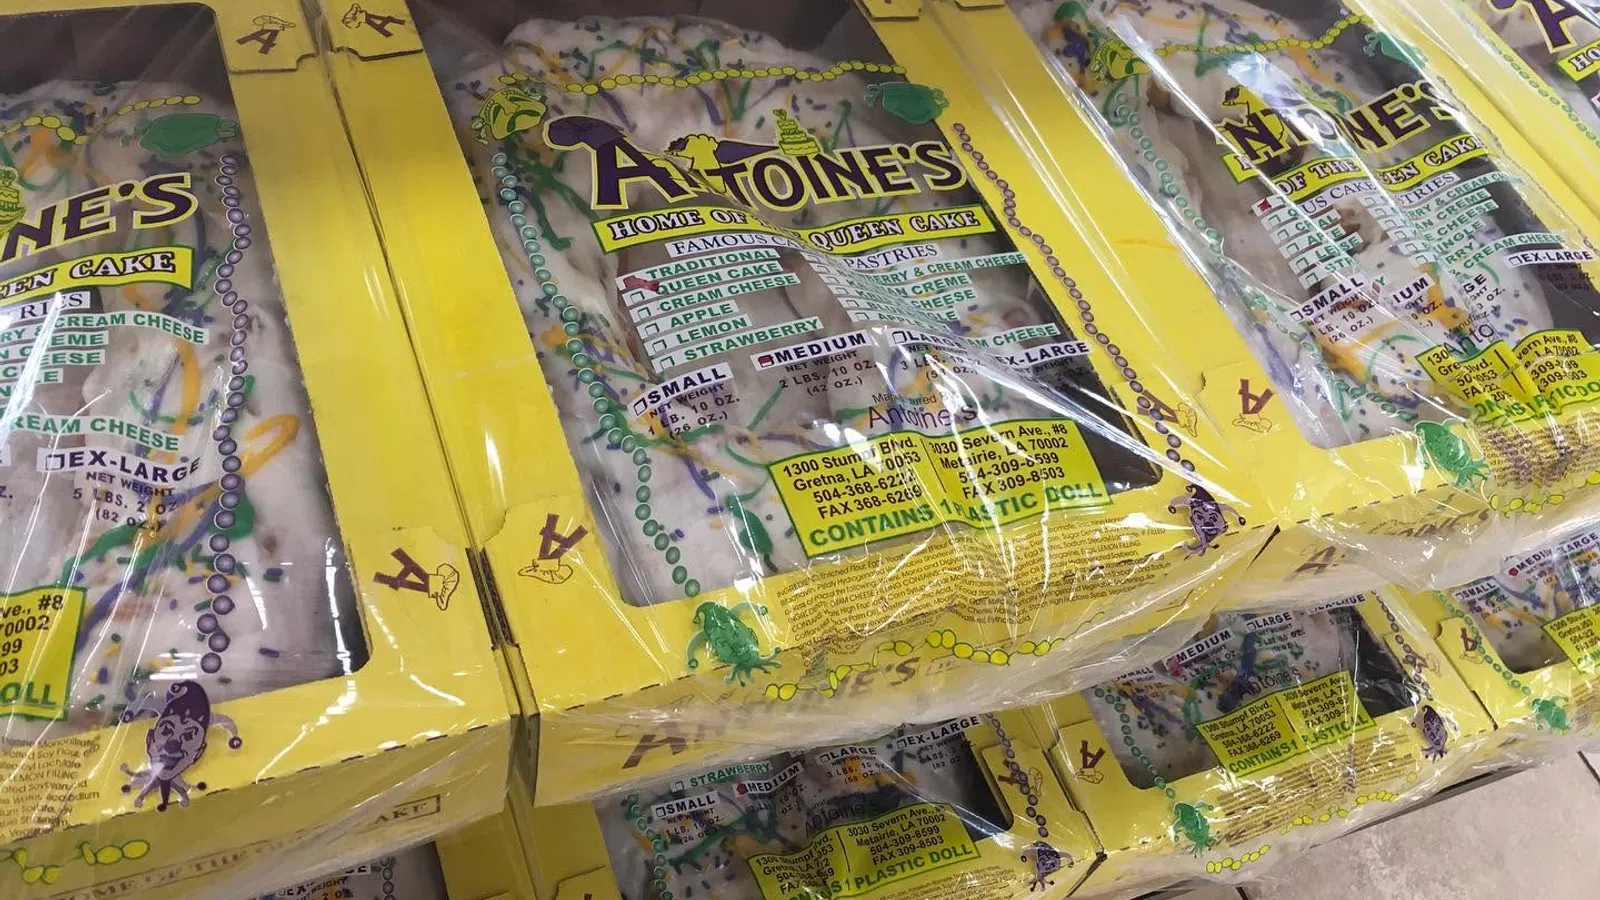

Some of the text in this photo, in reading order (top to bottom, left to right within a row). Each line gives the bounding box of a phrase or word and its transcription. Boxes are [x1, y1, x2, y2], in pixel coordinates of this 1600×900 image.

[1276, 161, 1361, 196] OF THE
[1446, 177, 1490, 199] CREAM
[1436, 190, 1491, 220] CREME
[1437, 201, 1498, 236] CHEESE
[608, 208, 749, 241] HOME OF
[809, 216, 904, 251] QUEEN
[909, 210, 980, 236] CAKE
[672, 234, 767, 255] FAMOUS
[842, 244, 938, 270] PASTRIES
[1463, 232, 1566, 270] CREAM CHEESE
[1522, 249, 1594, 262] EX-LARGE
[69, 251, 176, 282] CAKE
[645, 249, 778, 281] TRADITIONAL
[656, 261, 780, 297] QUEEN CAKE
[914, 267, 924, 277] &
[927, 260, 974, 274] CREAM
[977, 253, 1025, 267] CHEESE
[659, 275, 797, 313] CREAM CHEESE
[912, 275, 969, 296] CREME
[912, 289, 976, 309] CHEESE
[1301, 277, 1364, 316] SMALL
[1487, 287, 1507, 302] OZ.
[55, 313, 126, 328] CREAM
[133, 314, 205, 344] CHEESE
[670, 303, 734, 329] APPLE
[1328, 315, 1375, 345] (26 OZ.)
[1342, 310, 1356, 323] 10
[676, 317, 748, 345] LEMON
[685, 318, 820, 361] STRAWBERRY
[992, 324, 1058, 347] CHEESE
[775, 332, 867, 364] MEDIUM
[785, 351, 859, 374] NET WEIGHT
[998, 342, 1088, 366] EX-LARGE
[779, 360, 878, 389] 2 LBS. 10 OZ.
[901, 361, 908, 371] 3
[648, 366, 727, 405] SMALL
[806, 376, 864, 397] (42 OZ.)
[650, 383, 726, 419] NET WEIGHT
[661, 414, 686, 429] LB.
[692, 400, 707, 414] 10
[714, 396, 741, 408] OZ.
[90, 417, 178, 451] CHEESE
[669, 413, 728, 440] (26 OZ.)
[962, 430, 1013, 450] Severn
[1018, 425, 1049, 438] Ave.,
[1052, 424, 1067, 436] #8
[69, 450, 200, 483] EX-LARGE
[783, 459, 819, 479] 1300
[879, 436, 917, 457] Blvd.
[940, 437, 1068, 469] Metairie, LA 70002
[86, 471, 175, 497] NET WEIGHT
[793, 472, 850, 493] Gretna,
[851, 464, 875, 480] LA
[962, 467, 1065, 500] FAX 309-8503
[73, 488, 82, 500] 5
[93, 491, 128, 509] LBS.
[137, 501, 145, 513] 2
[809, 482, 1104, 546] CONTAINS 1 PLASTIC DOLL
[818, 484, 922, 519] FAX 368-6269
[1560, 532, 1598, 553] LARGE
[38, 594, 64, 611] #8
[1462, 582, 1496, 598] SMALL
[1255, 612, 1292, 628] LARGE
[1176, 630, 1231, 663] MEDIUM
[1323, 688, 1337, 698] LA
[907, 715, 980, 745] EX-LARGE
[1220, 712, 1249, 729] Stumpf
[1250, 702, 1273, 716] Blvd.
[1236, 725, 1249, 734] LA
[1251, 711, 1277, 727] 70053
[829, 746, 877, 759] LARGE
[1228, 747, 1244, 758] FAX
[1228, 742, 1292, 773] CONTAINS
[1292, 739, 1298, 750] 1
[690, 762, 771, 787] STRAWBERRY
[747, 765, 800, 793] MEDIUM
[666, 794, 716, 815] SMALL
[848, 806, 933, 838] 3030 Severn Ave.,
[856, 813, 947, 848] Metairie, LA 70002
[870, 825, 940, 856] 504-309-8599
[872, 837, 945, 866] FAX 309-8503
[856, 854, 925, 889] PLASTIC
[929, 844, 973, 864] DOLL
